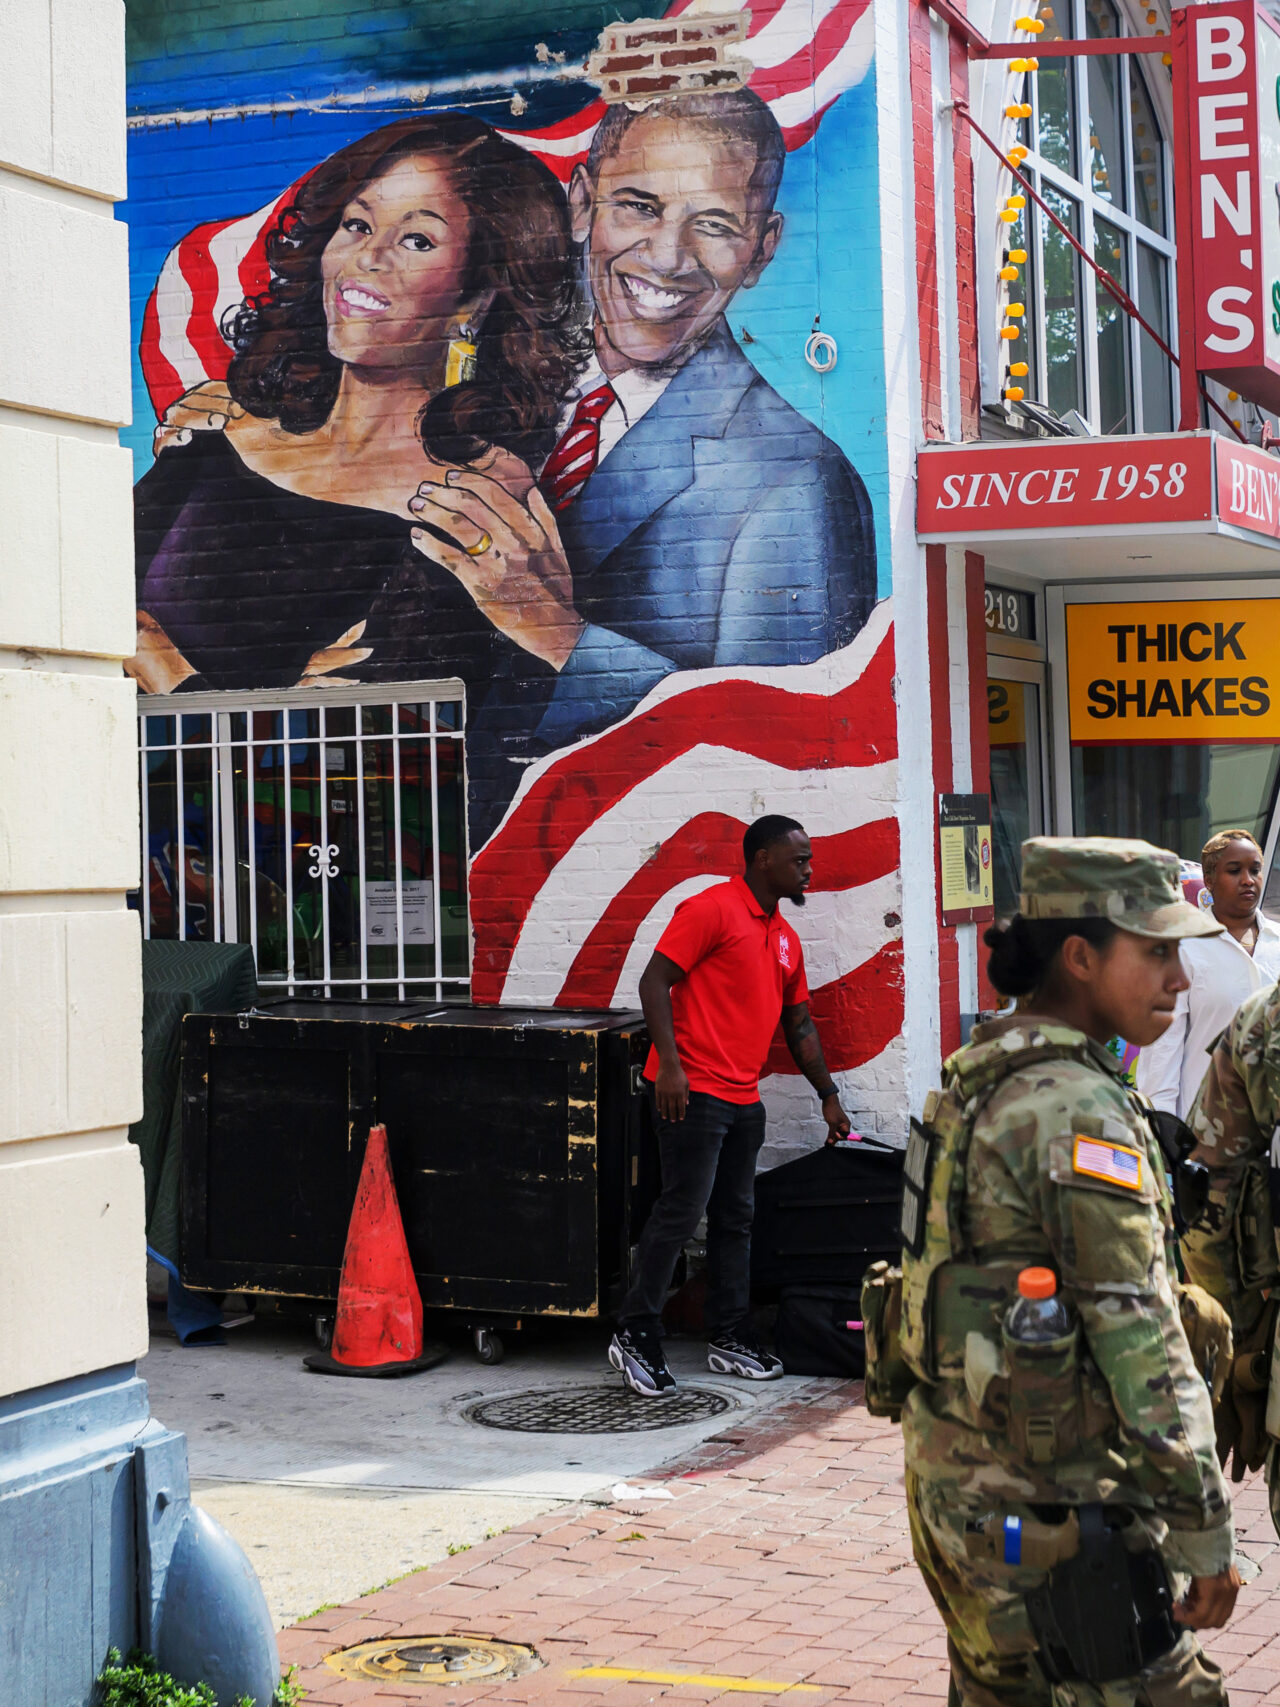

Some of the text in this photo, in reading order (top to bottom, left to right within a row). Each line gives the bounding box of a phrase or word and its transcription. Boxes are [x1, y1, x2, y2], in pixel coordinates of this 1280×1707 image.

[936, 462, 1187, 510] SINCE 1958
[1108, 621, 1247, 663] THICK
[1087, 676, 1271, 720] SHAKES
